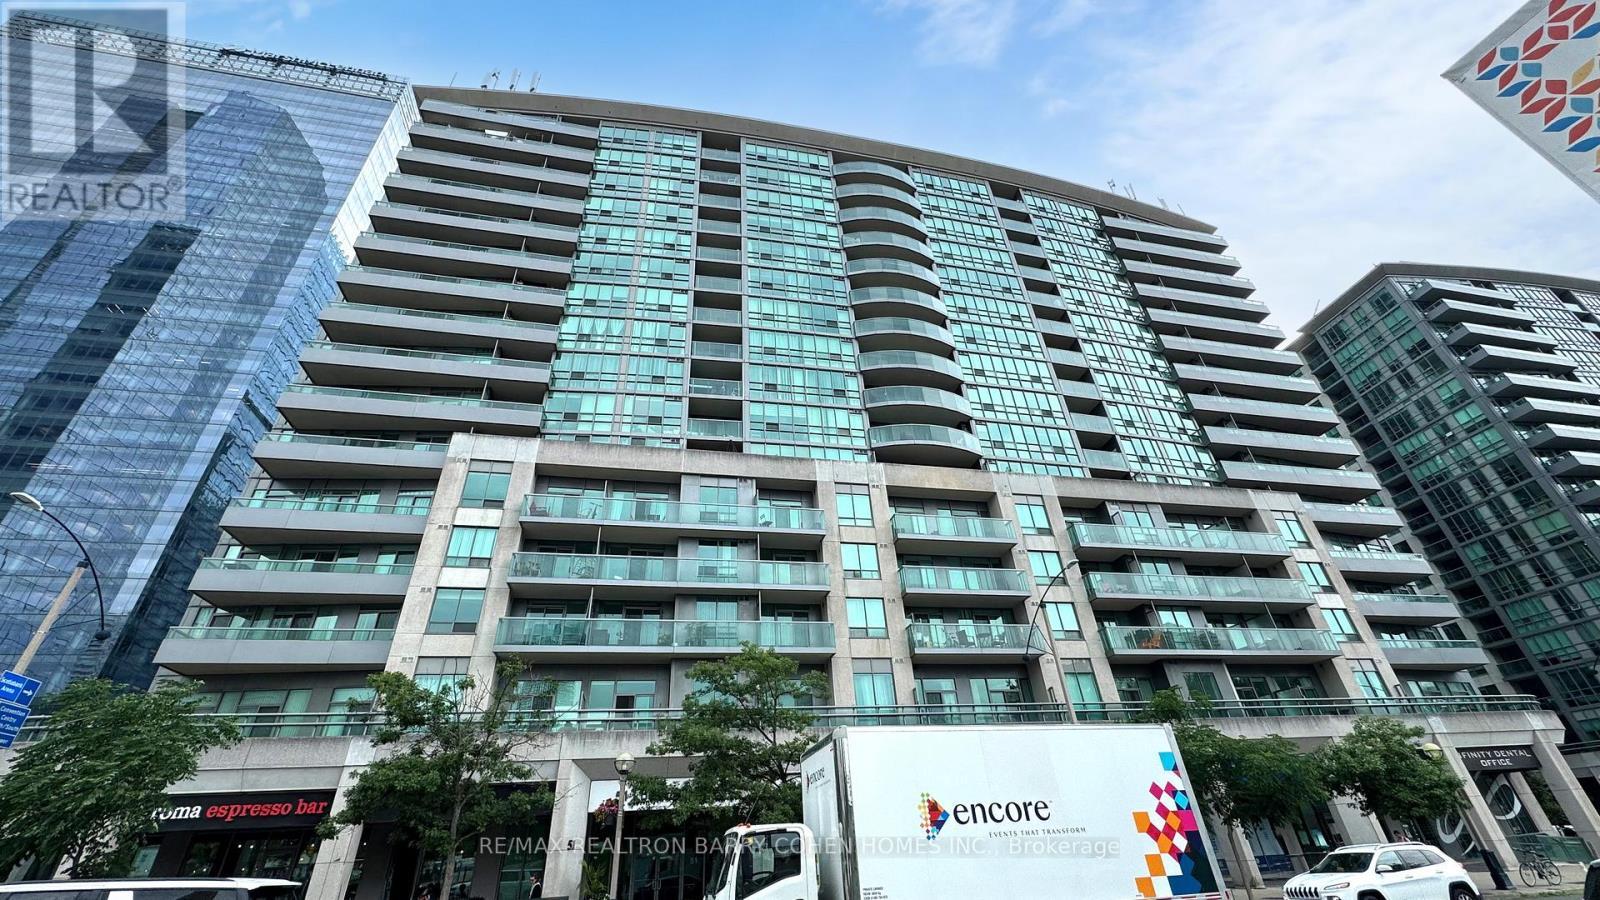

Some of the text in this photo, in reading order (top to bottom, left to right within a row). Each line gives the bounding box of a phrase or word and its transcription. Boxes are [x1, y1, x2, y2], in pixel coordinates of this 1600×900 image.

[1461, 749, 1532, 759] FINITY DENTAL
[1480, 758, 1513, 767] OFFICE
[150, 798, 328, 822] roma espresso bar
[953, 800, 1051, 825] encore
[989, 826, 1087, 839] EVENTS THAT TRANSFORM
